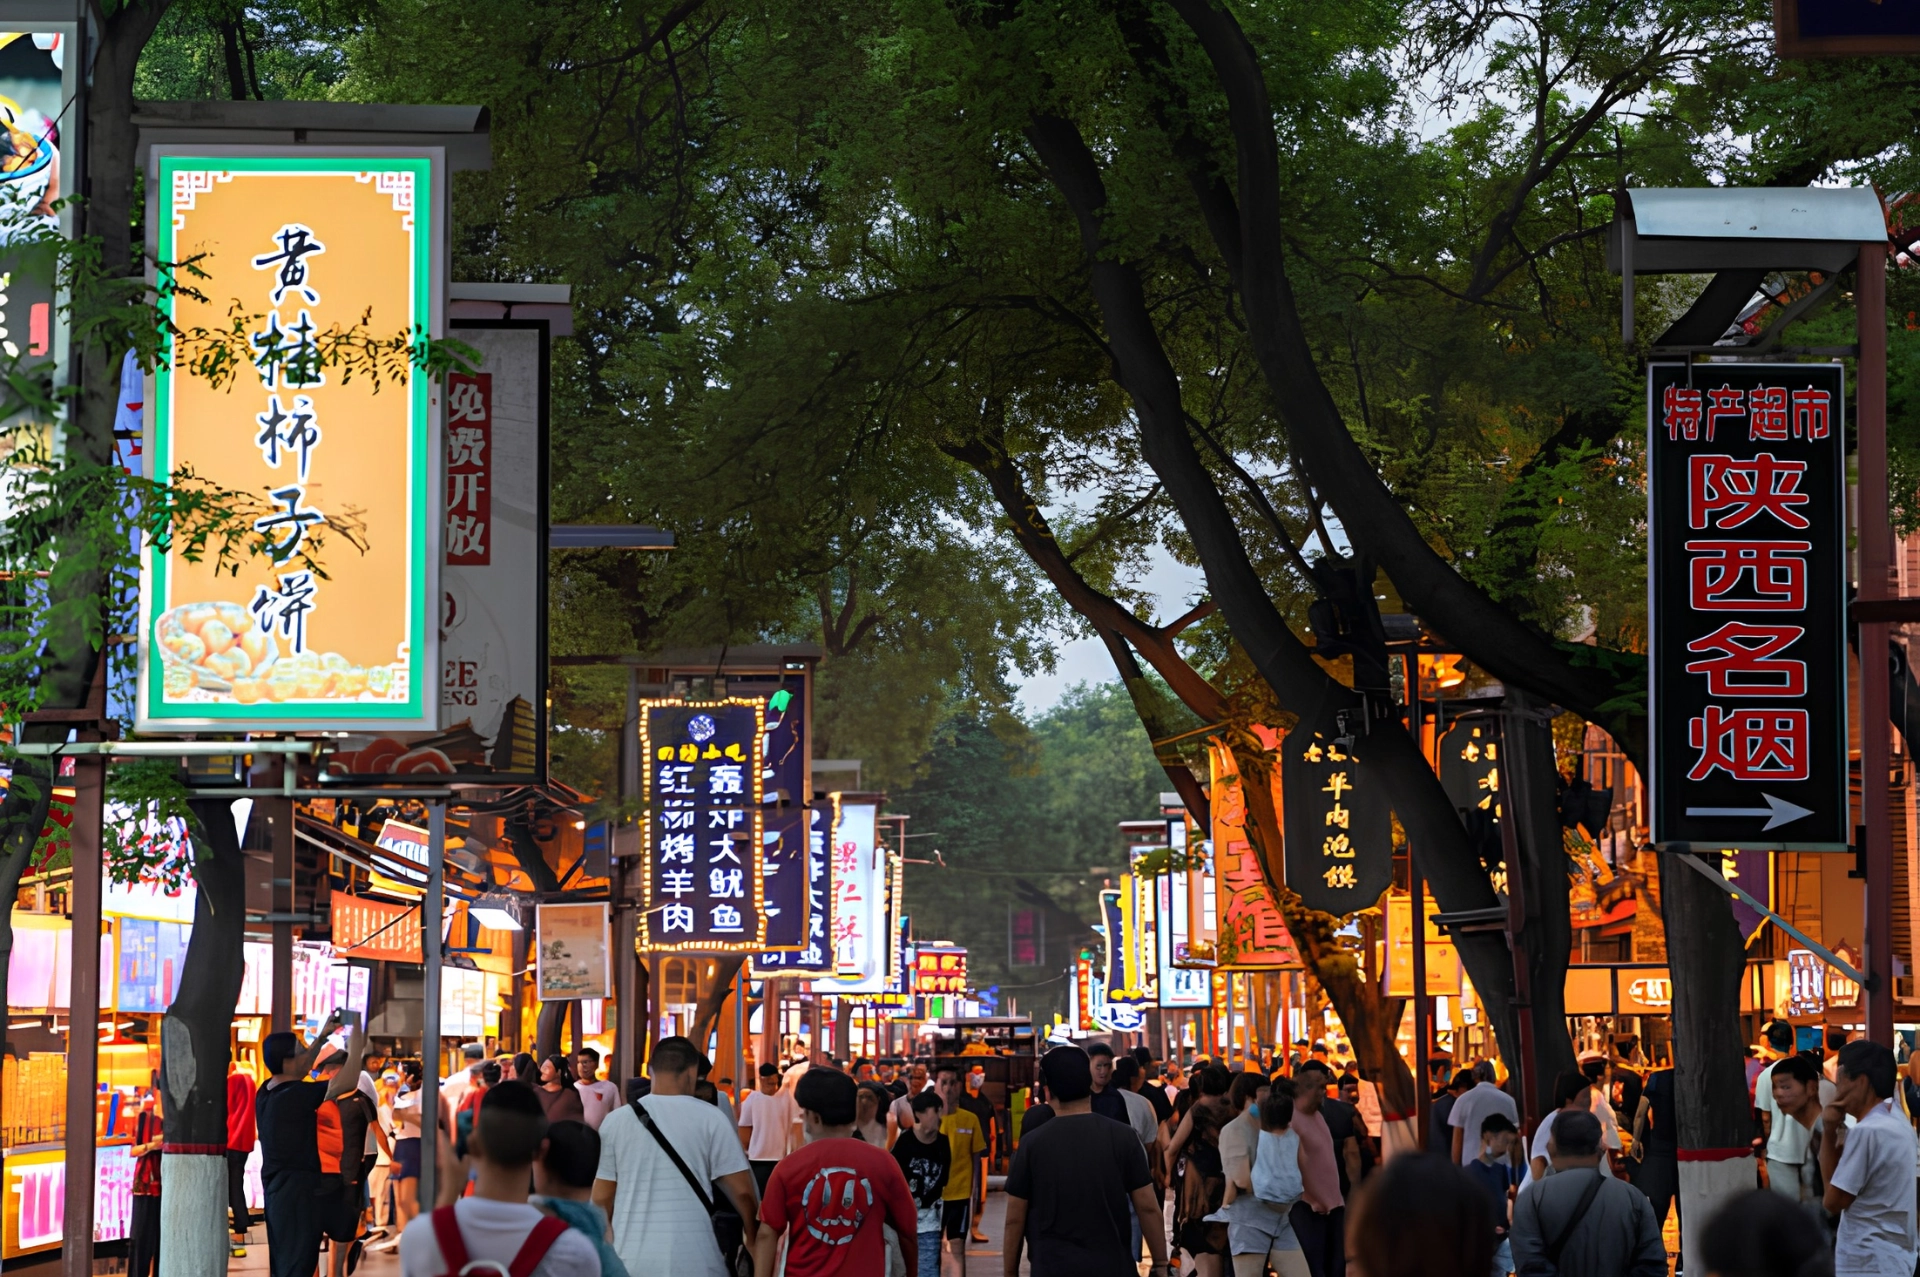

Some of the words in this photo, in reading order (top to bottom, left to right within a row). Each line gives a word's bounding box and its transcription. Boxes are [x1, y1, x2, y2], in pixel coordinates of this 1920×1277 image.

[252, 223, 327, 656] 黄桂柿子饼
[1664, 384, 1831, 442] 特产超市
[1684, 453, 1812, 781] 陕西名烟
